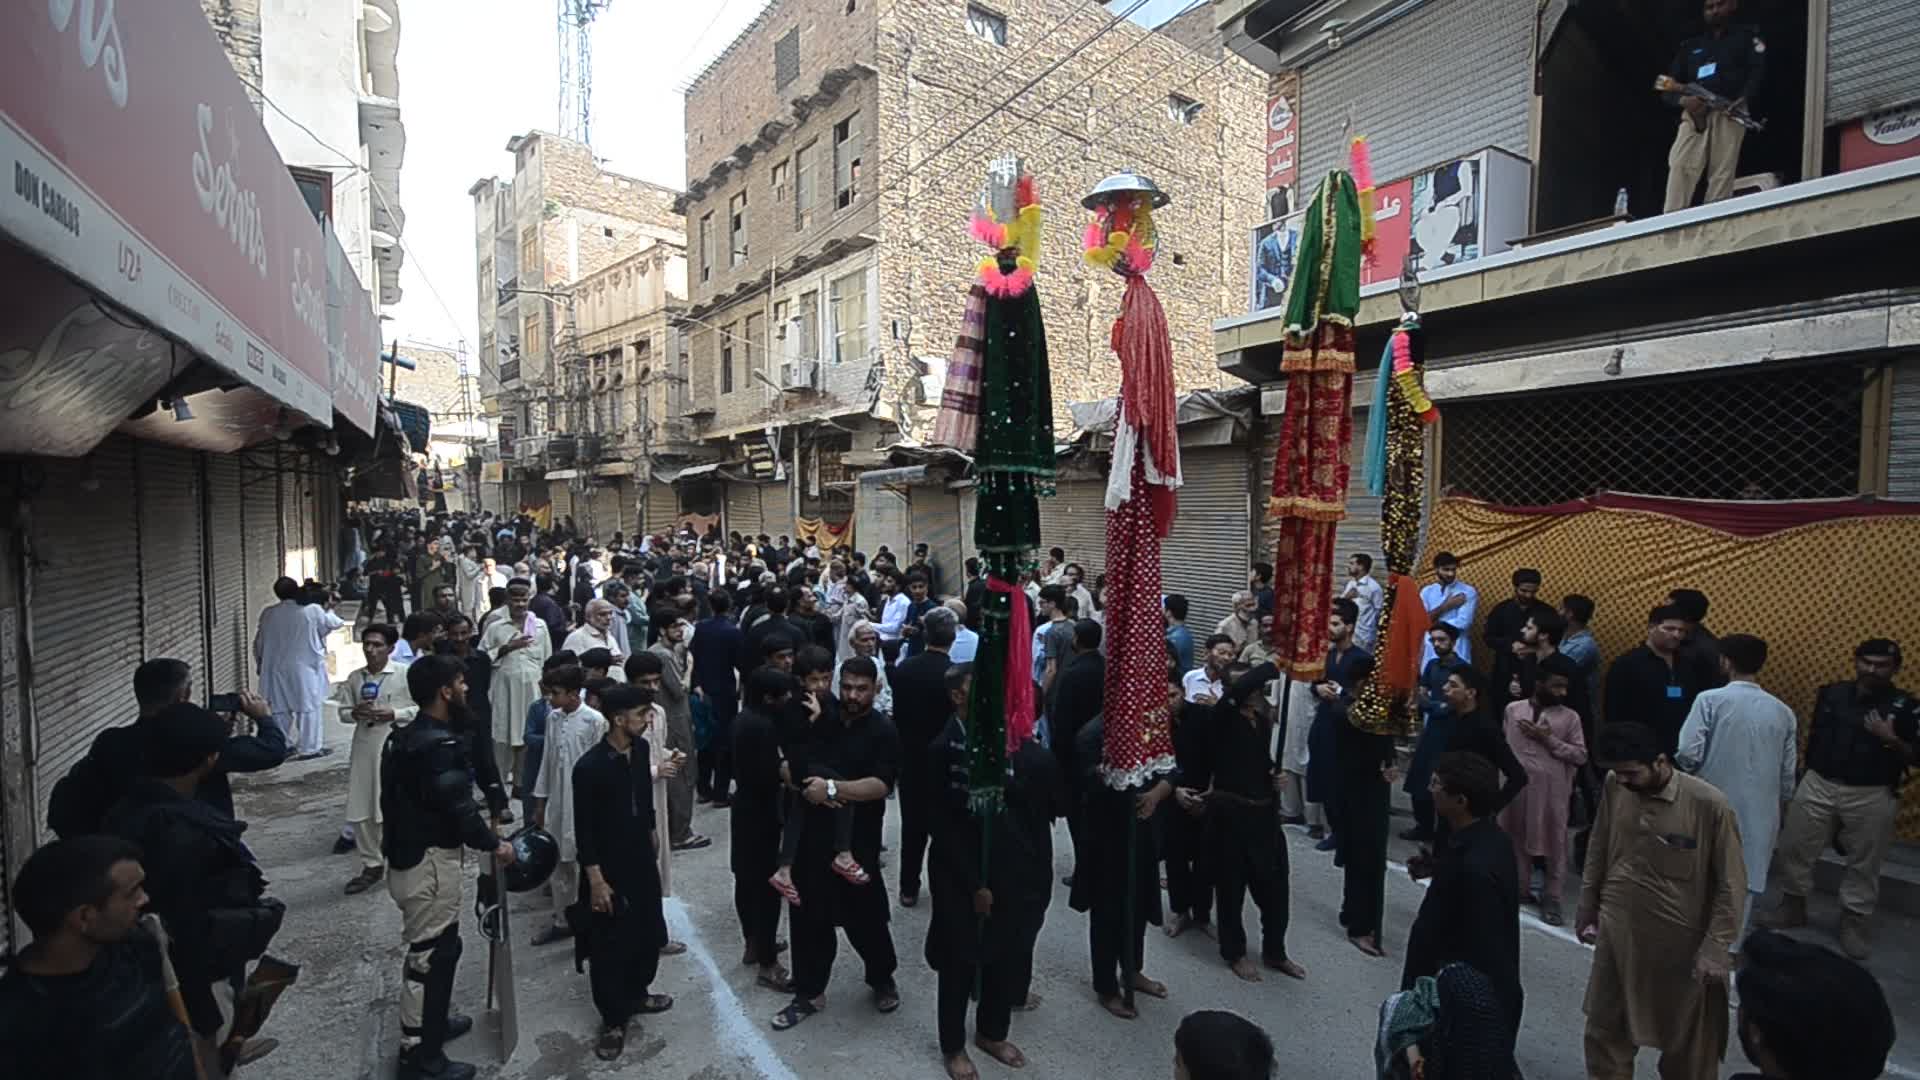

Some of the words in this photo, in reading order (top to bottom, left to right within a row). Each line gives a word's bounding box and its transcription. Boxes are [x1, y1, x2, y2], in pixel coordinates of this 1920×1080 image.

[15, 160, 40, 208] DON
[42, 181, 80, 237] CARLOS
[192, 103, 268, 279] Servis
